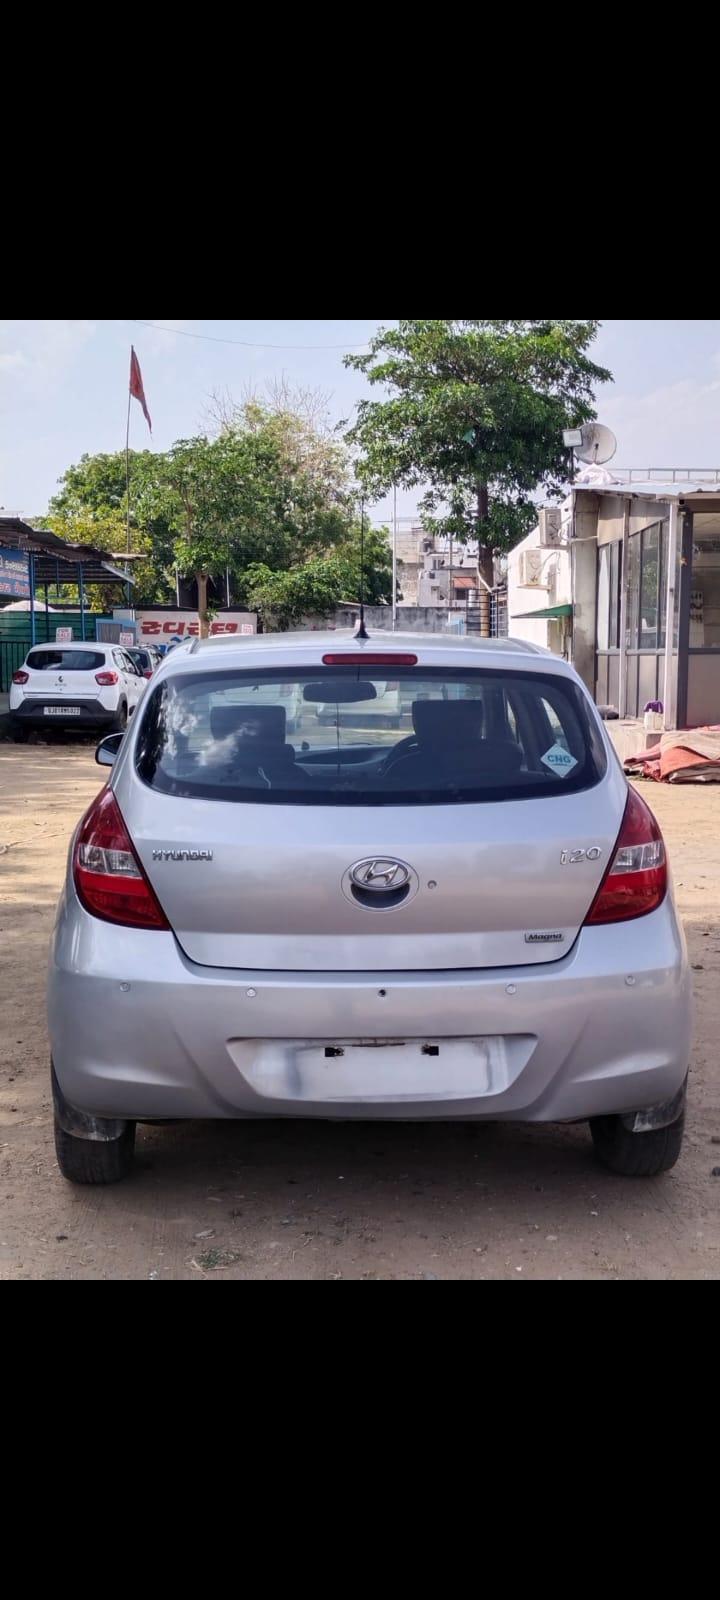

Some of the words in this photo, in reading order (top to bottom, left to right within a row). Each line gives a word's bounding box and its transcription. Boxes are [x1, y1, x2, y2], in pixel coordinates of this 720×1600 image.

[547, 755, 571, 763] CNG
[152, 849, 213, 861] HYUNDAI
[560, 846, 602, 865] i20
[528, 933, 562, 941] Magna
